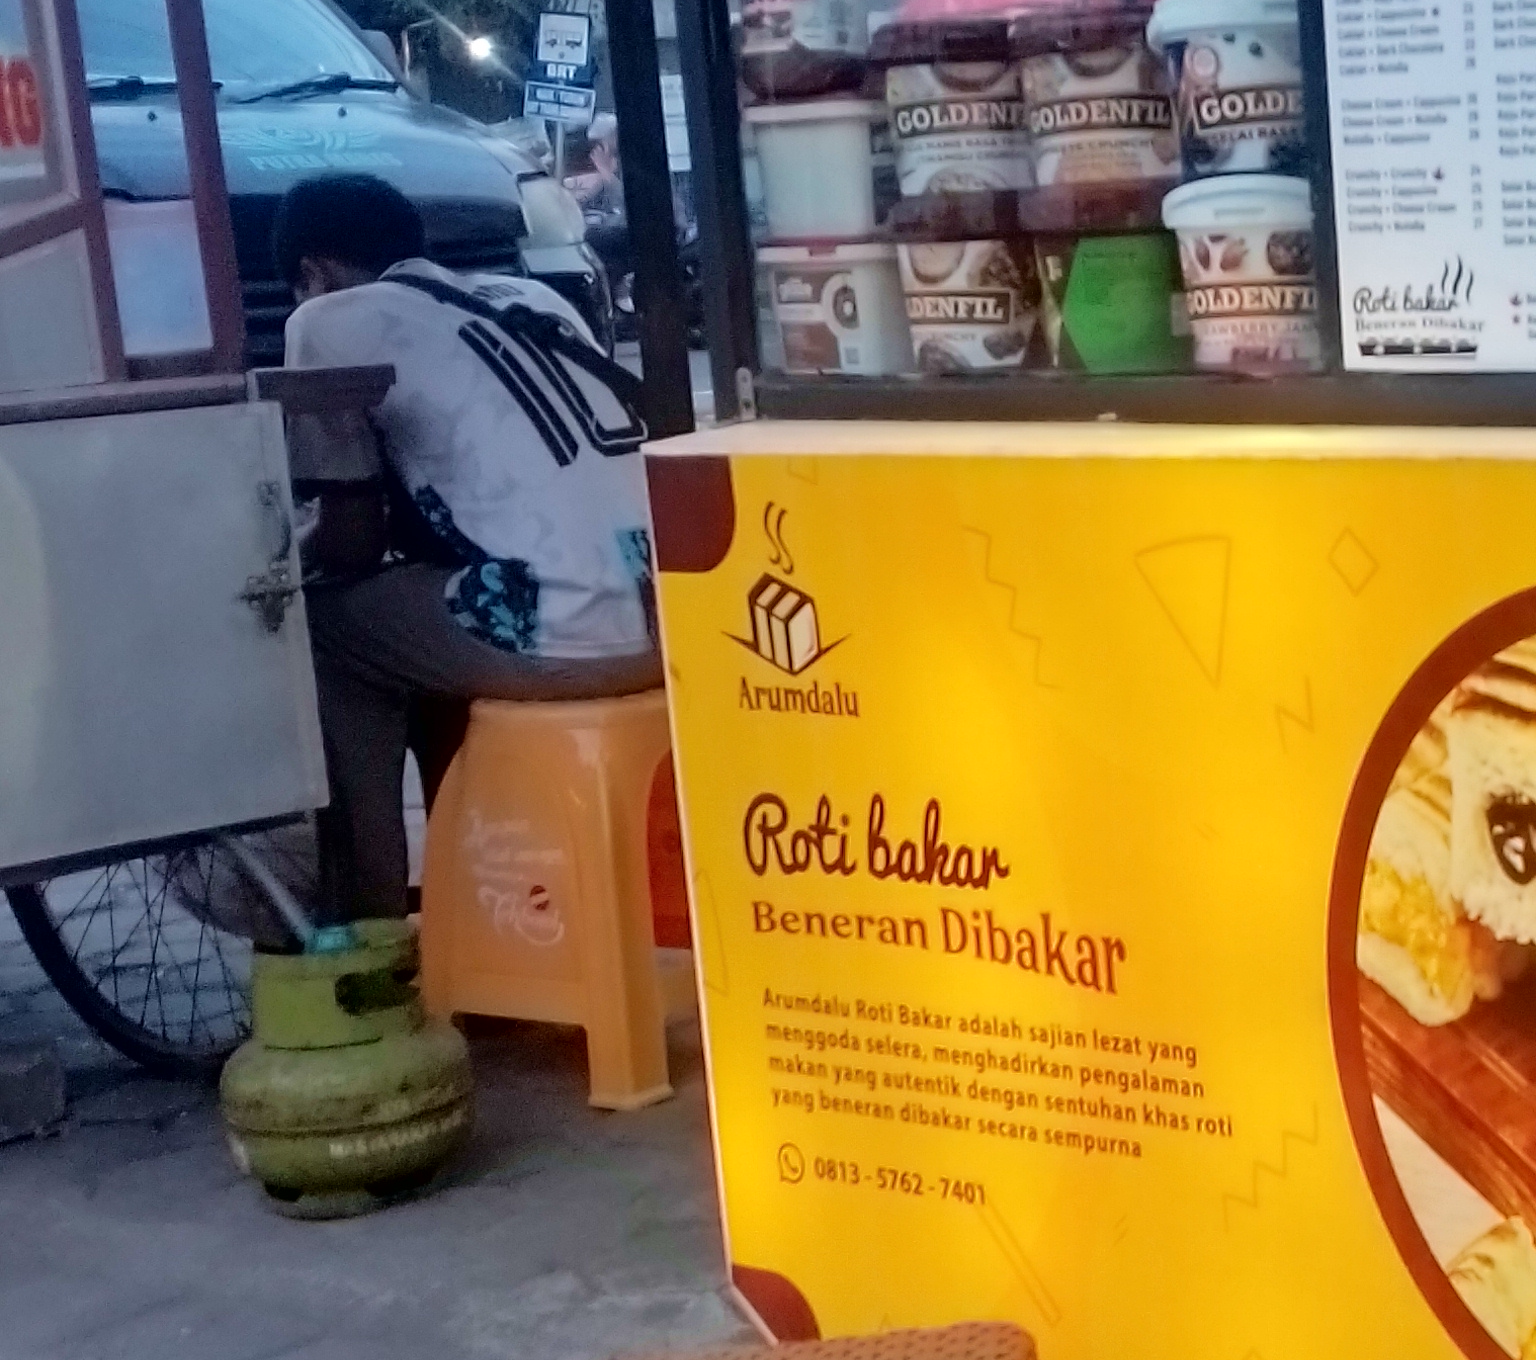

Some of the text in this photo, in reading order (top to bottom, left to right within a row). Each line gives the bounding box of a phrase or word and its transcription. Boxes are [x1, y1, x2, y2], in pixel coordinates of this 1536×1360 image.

[905, 295, 1004, 320] DENFIL
[1187, 285, 1317, 315] OLDENFI
[1353, 283, 1458, 314] Roti bakar
[739, 677, 861, 718] Arumdalu
[744, 792, 1011, 890] Roti bakar
[752, 900, 1128, 996] Beneran Dibakar
[763, 987, 1197, 1069] Arumdalu Roti Bakar adalah sajian lezat yang
[766, 1023, 1205, 1099] menggoda selera, menghadirkan pengalaman
[769, 1053, 1233, 1138] makan yang autentik dengan sentuhan khas roti
[772, 1088, 1143, 1158] yang beneran dibakar secara sempurna
[814, 1155, 861, 1185] 0813
[876, 1166, 925, 1196] 5762
[939, 1176, 987, 1206] 7401
